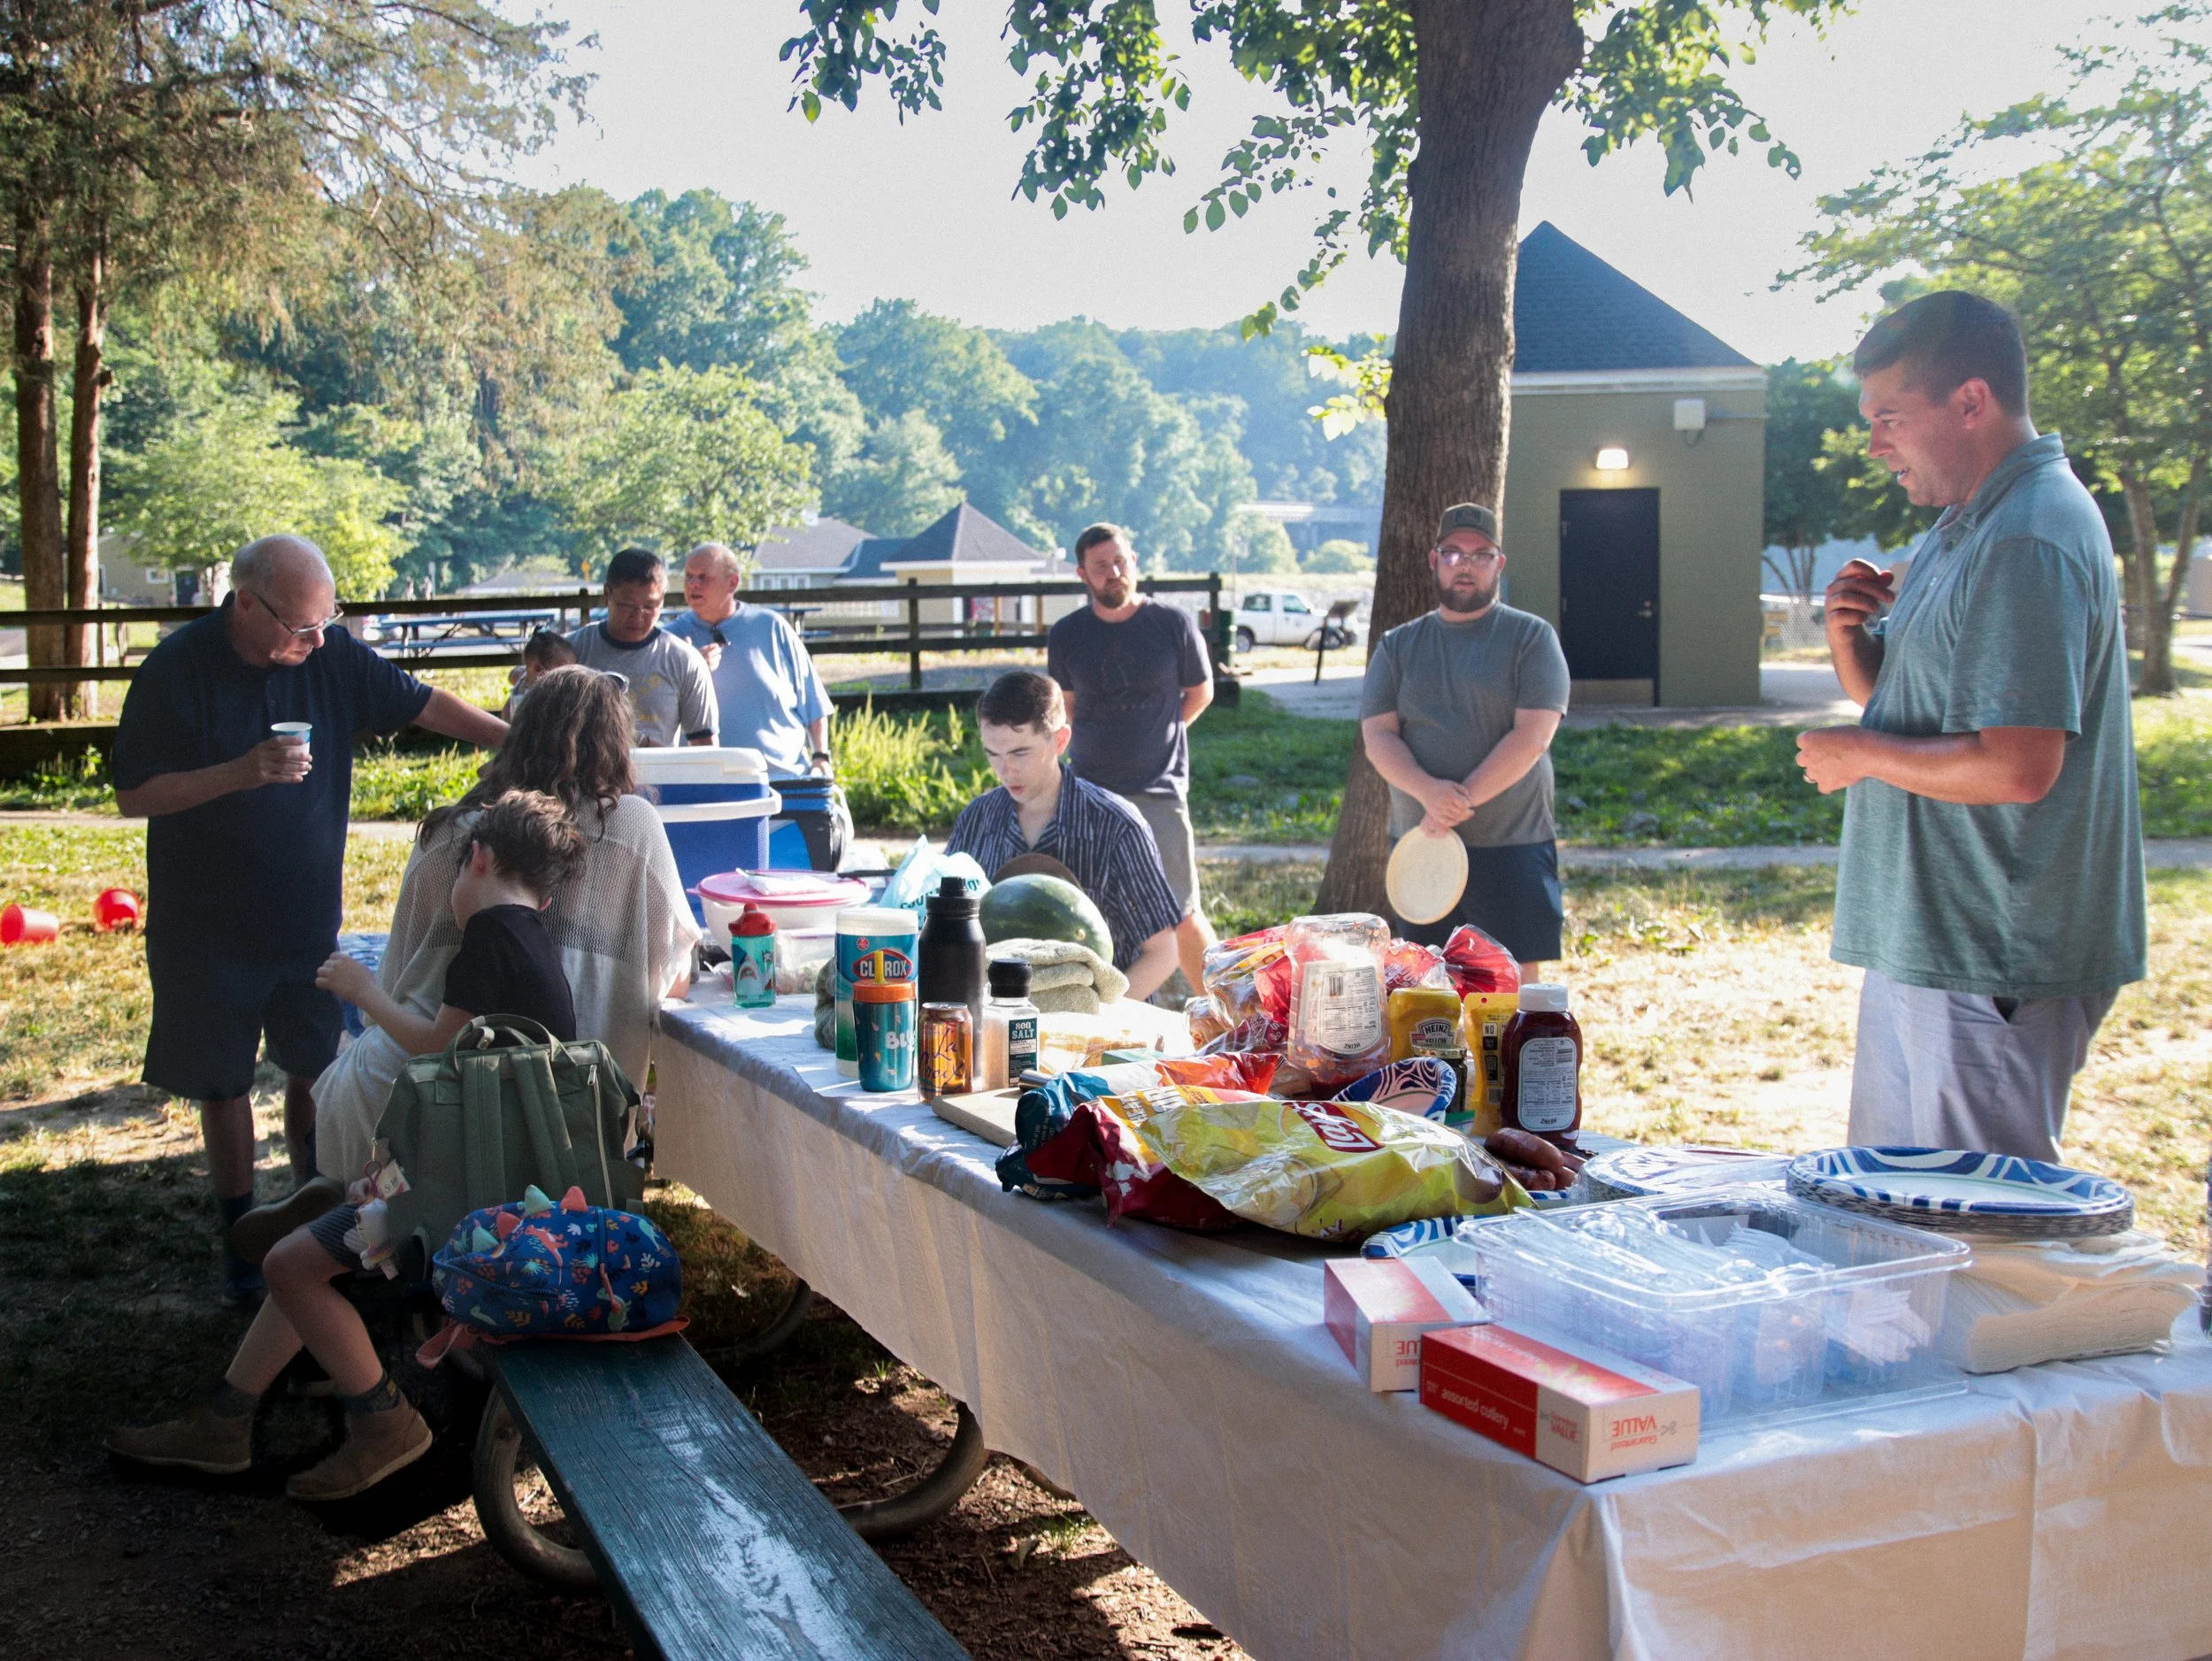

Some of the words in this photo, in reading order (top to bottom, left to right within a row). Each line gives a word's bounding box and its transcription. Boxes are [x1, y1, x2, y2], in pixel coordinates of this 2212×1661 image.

[859, 960, 906, 977] CLROX
[1011, 1028, 1034, 1040] SALT
[1425, 1024, 1448, 1034] HEINZ
[1485, 1025, 1494, 1034] NO
[1442, 1387, 1479, 1414] assorted
[1480, 1405, 1509, 1430] cutlery
[1550, 1421, 1578, 1443] VALUE
[1612, 1415, 1657, 1437] VALUE
